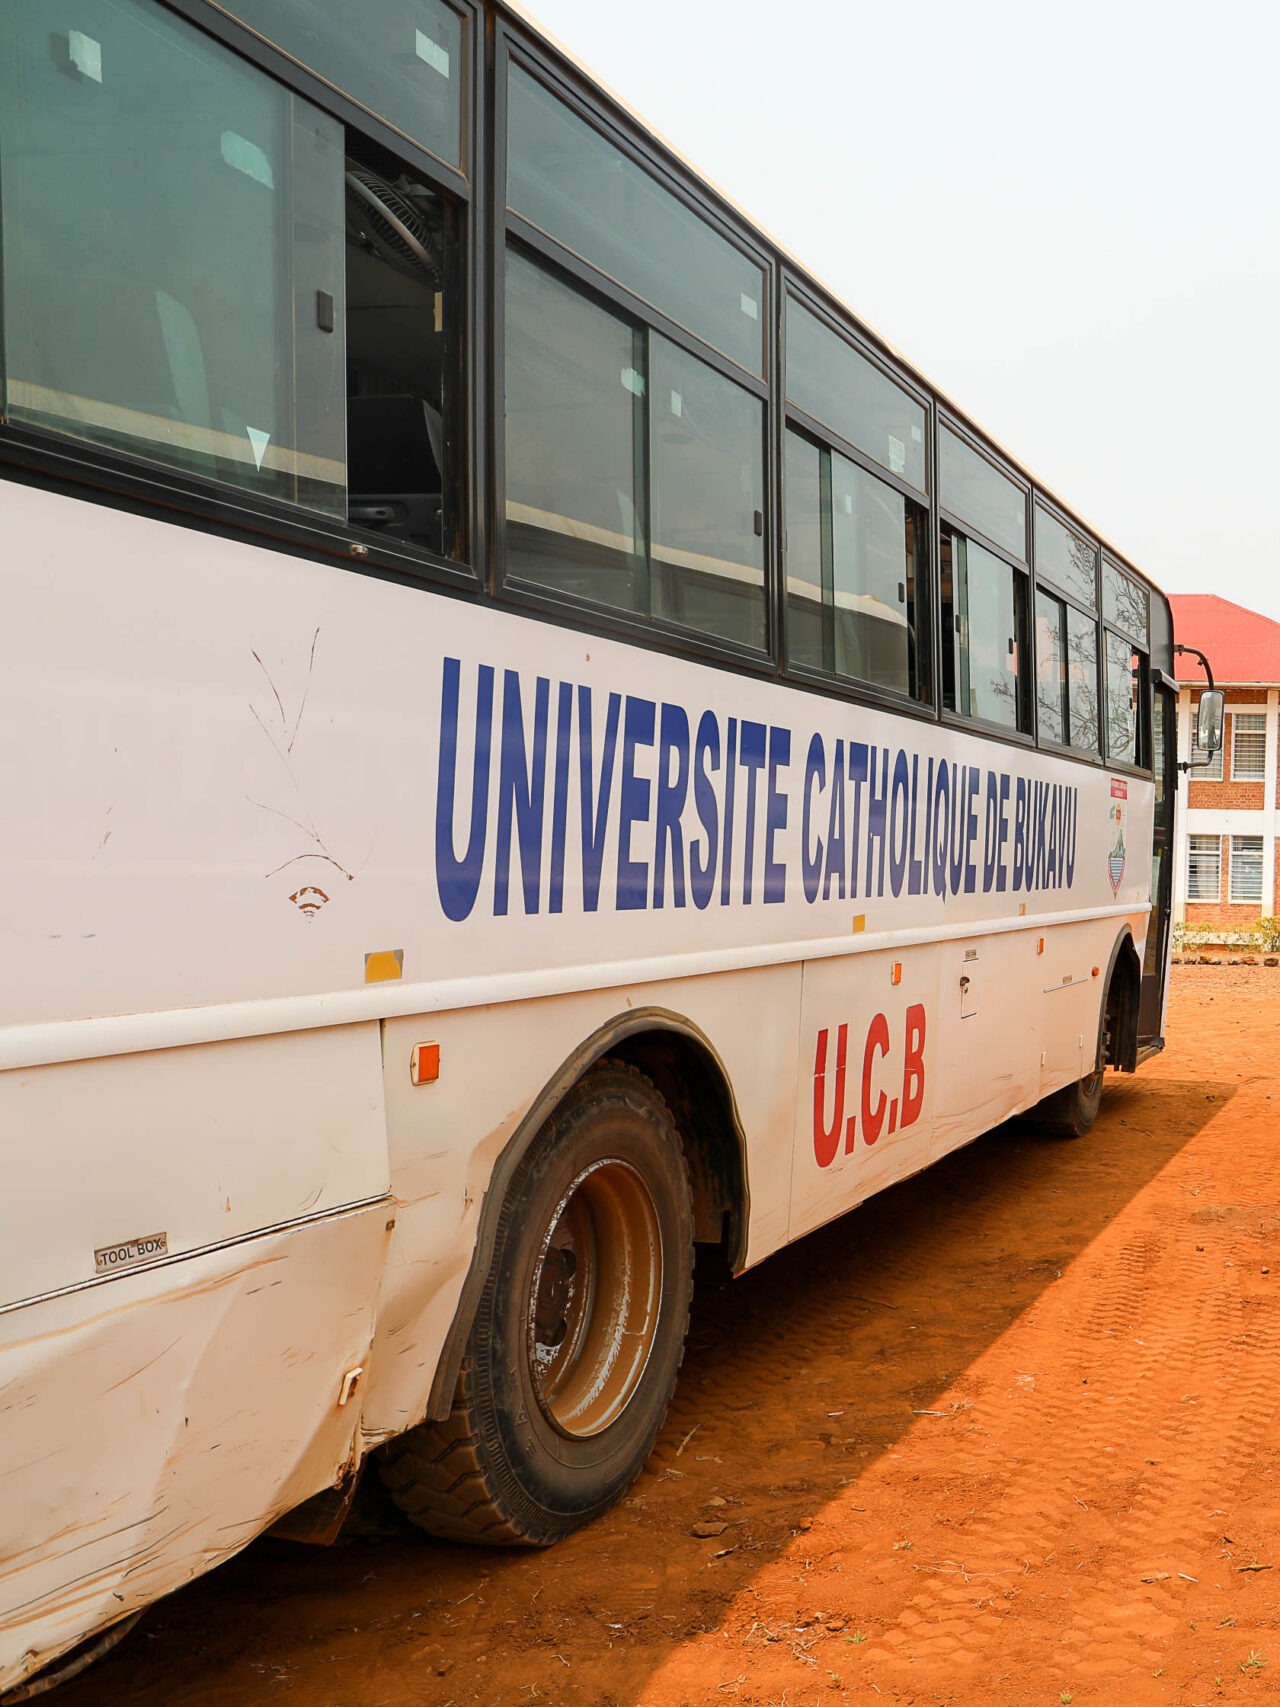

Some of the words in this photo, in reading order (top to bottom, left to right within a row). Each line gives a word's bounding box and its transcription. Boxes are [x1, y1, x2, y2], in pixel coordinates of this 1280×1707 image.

[435, 656, 791, 922] UNIVERSITE
[802, 731, 980, 904] CATHOLIQUE
[983, 769, 1011, 893] DE
[1012, 776, 1078, 892] BUKAVU
[813, 1003, 926, 1168] U.C.B
[101, 1246, 135, 1265] TOOL
[137, 1238, 162, 1255] BOX
